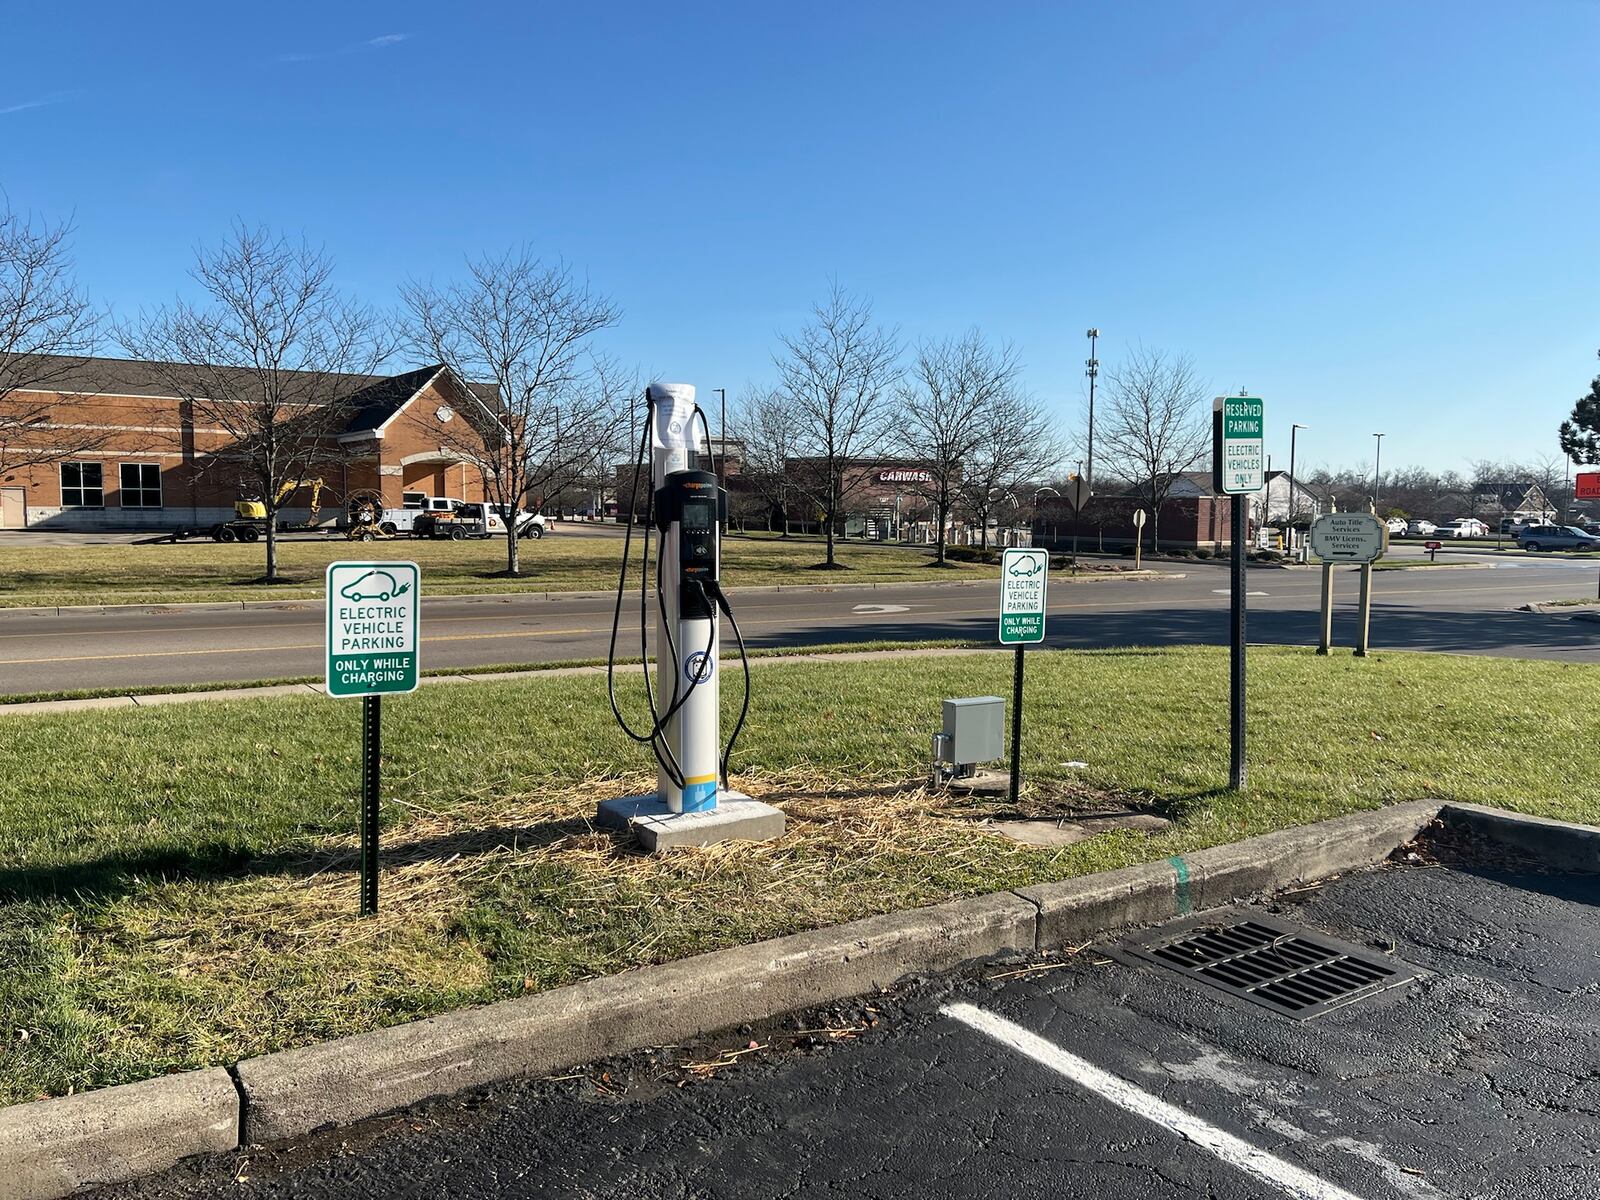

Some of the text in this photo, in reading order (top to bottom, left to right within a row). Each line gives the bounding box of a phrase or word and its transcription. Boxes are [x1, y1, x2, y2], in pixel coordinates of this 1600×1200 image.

[1226, 404, 1262, 416] RESERVED
[1228, 421, 1259, 432] PARKING
[1228, 445, 1259, 456] ELECTRIC
[1227, 459, 1260, 469] VEHICLES
[880, 471, 932, 481] CARWASH
[1235, 473, 1252, 484] ONLY
[1007, 580, 1040, 589] ELECTRIC
[1008, 591, 1038, 600] VEHICLE
[1007, 602, 1038, 611] PARKING
[340, 606, 406, 619] ELECTRIC
[1003, 617, 1040, 626] ONLY WHILE
[343, 621, 404, 634] VEHICLE
[1006, 626, 1037, 635] CHARGING
[342, 637, 404, 650] PARKING
[335, 657, 410, 672] ONLY WHILE
[341, 670, 404, 684] CHARGING
